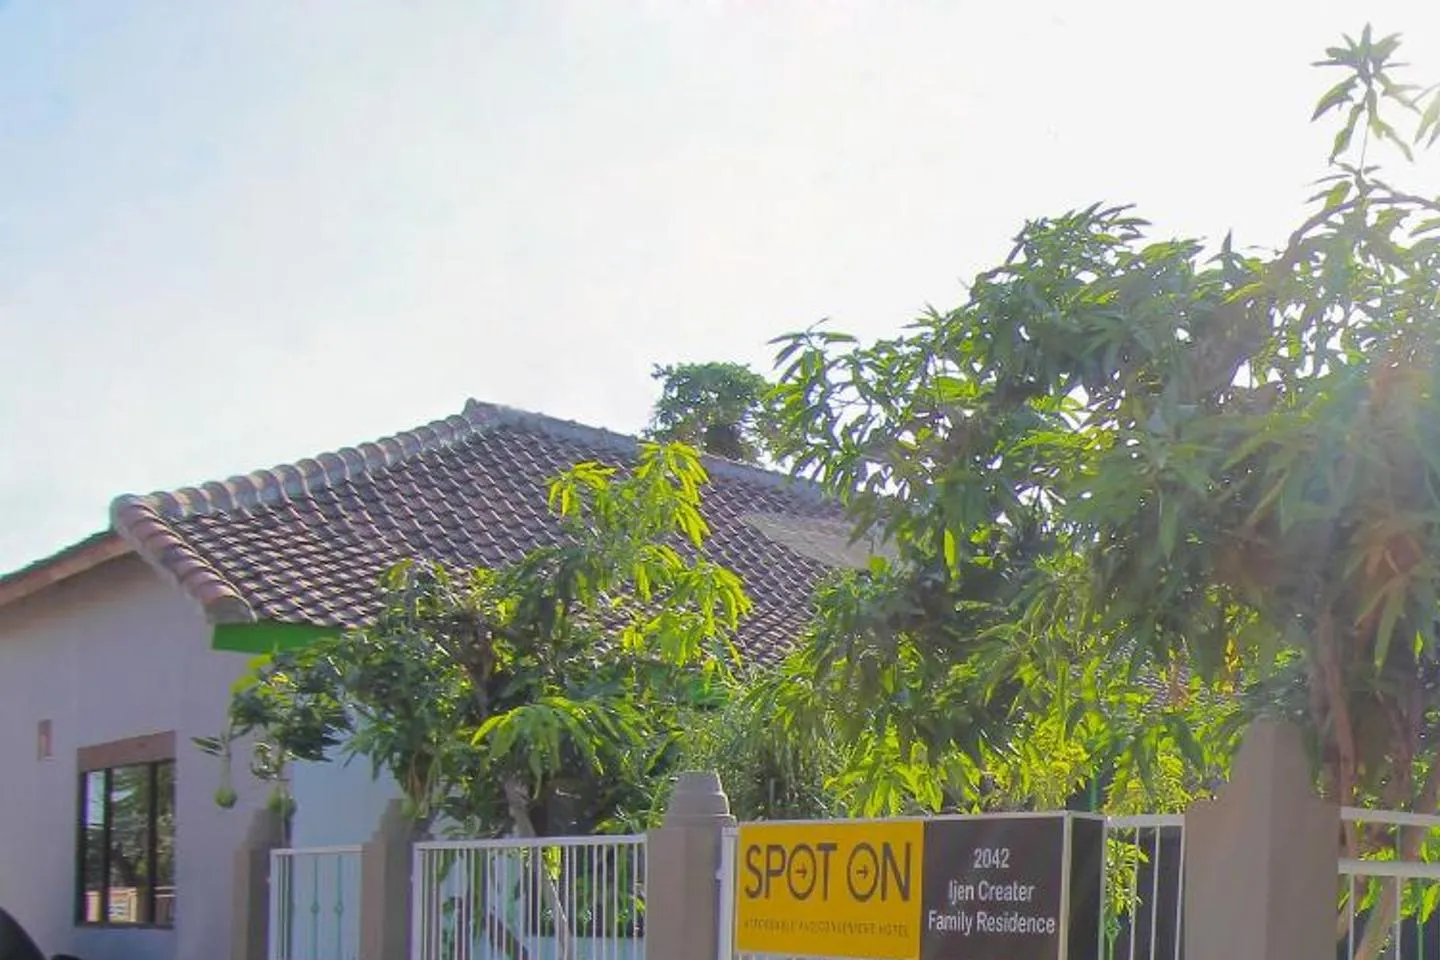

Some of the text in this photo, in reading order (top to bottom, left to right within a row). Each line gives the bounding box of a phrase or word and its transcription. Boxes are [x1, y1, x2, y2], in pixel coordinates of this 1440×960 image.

[745, 841, 911, 902] SPOT ON
[973, 848, 1010, 869] 2042
[948, 880, 1034, 905] Ijen Creater
[928, 909, 1056, 936] Family Residence
